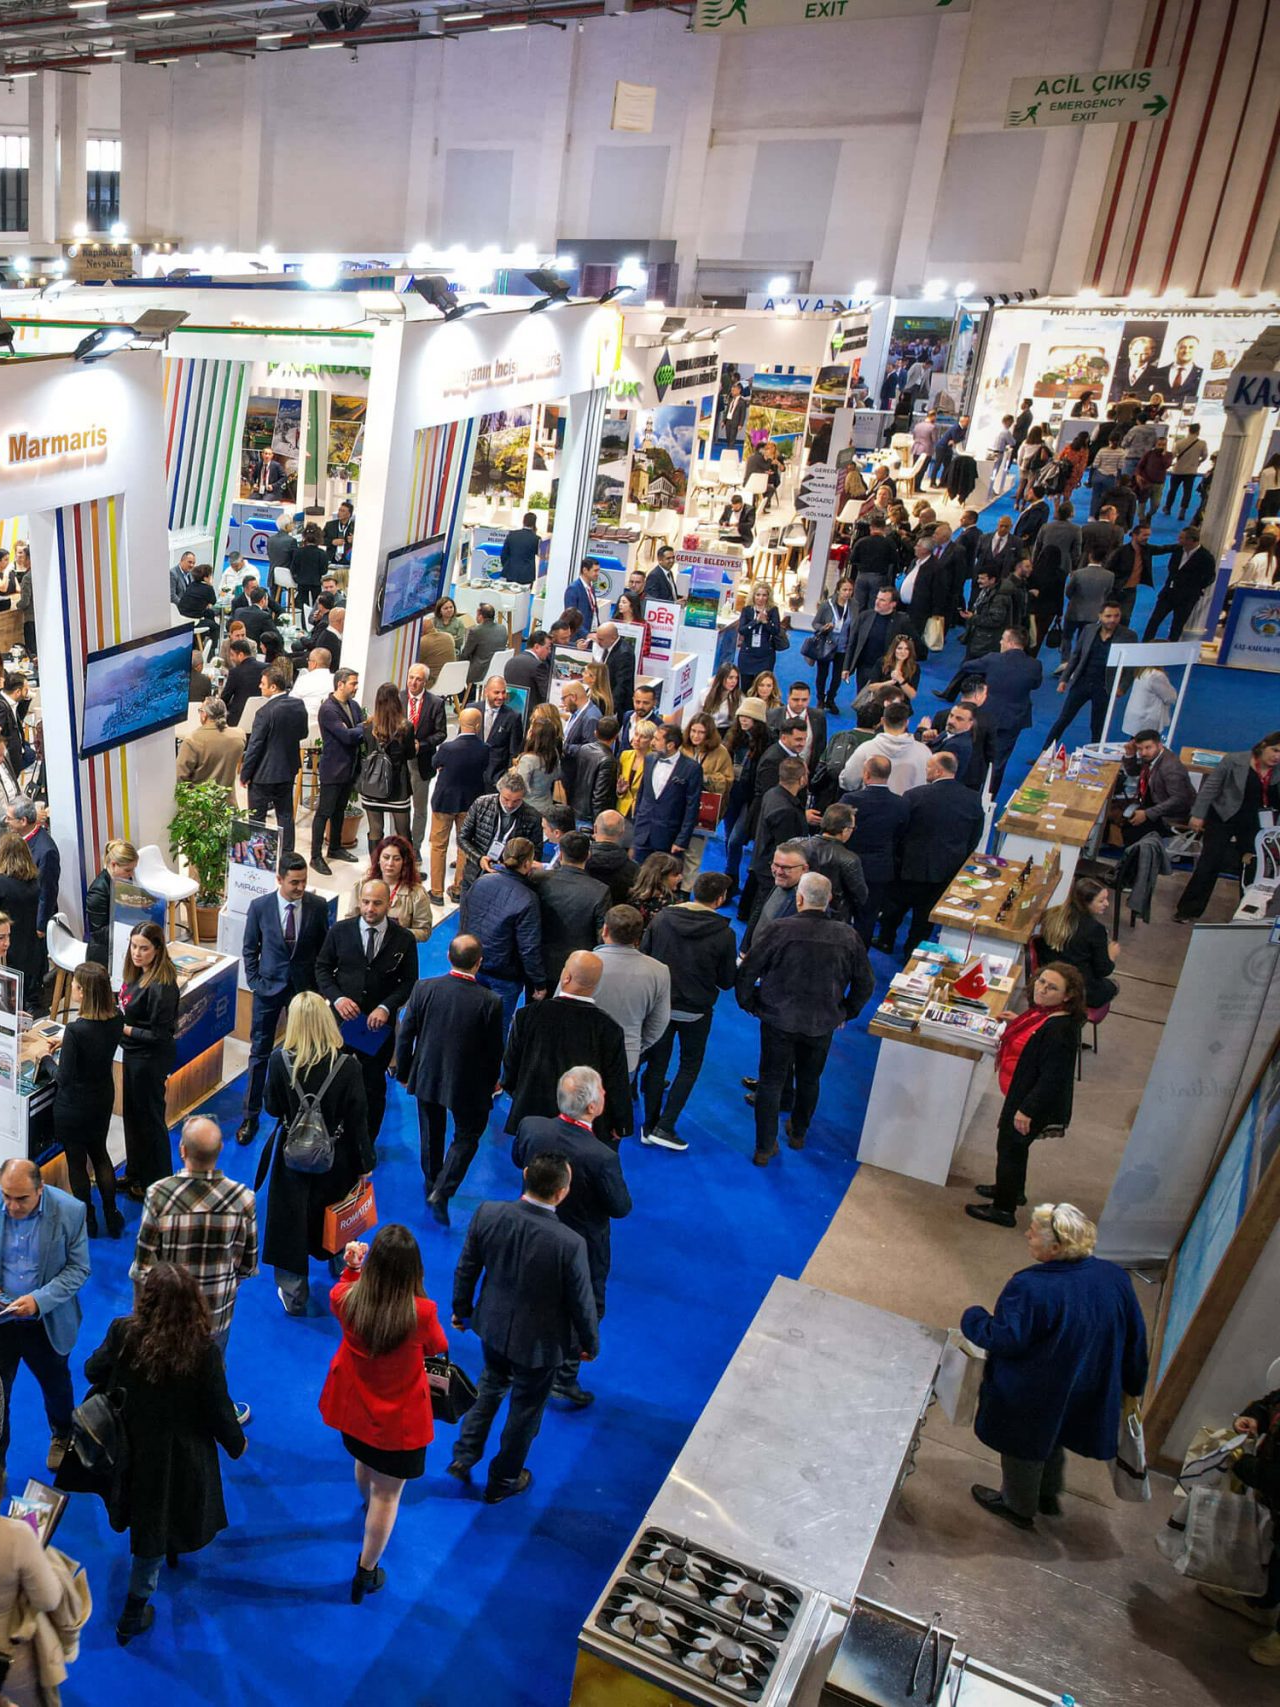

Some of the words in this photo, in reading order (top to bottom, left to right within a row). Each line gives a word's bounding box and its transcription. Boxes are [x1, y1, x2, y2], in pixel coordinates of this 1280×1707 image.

[805, 1, 848, 18] EXIT
[1034, 73, 1084, 96] ACİL
[1092, 71, 1151, 95] ÇIKIŞ
[1049, 98, 1126, 112] EMERGENCY
[1071, 112, 1097, 122] EXIT
[8, 423, 108, 463] Marmaris
[675, 554, 701, 564] GEREDE
[234, 880, 269, 895] MIRAGE
[340, 1195, 373, 1230] ROMATEM
